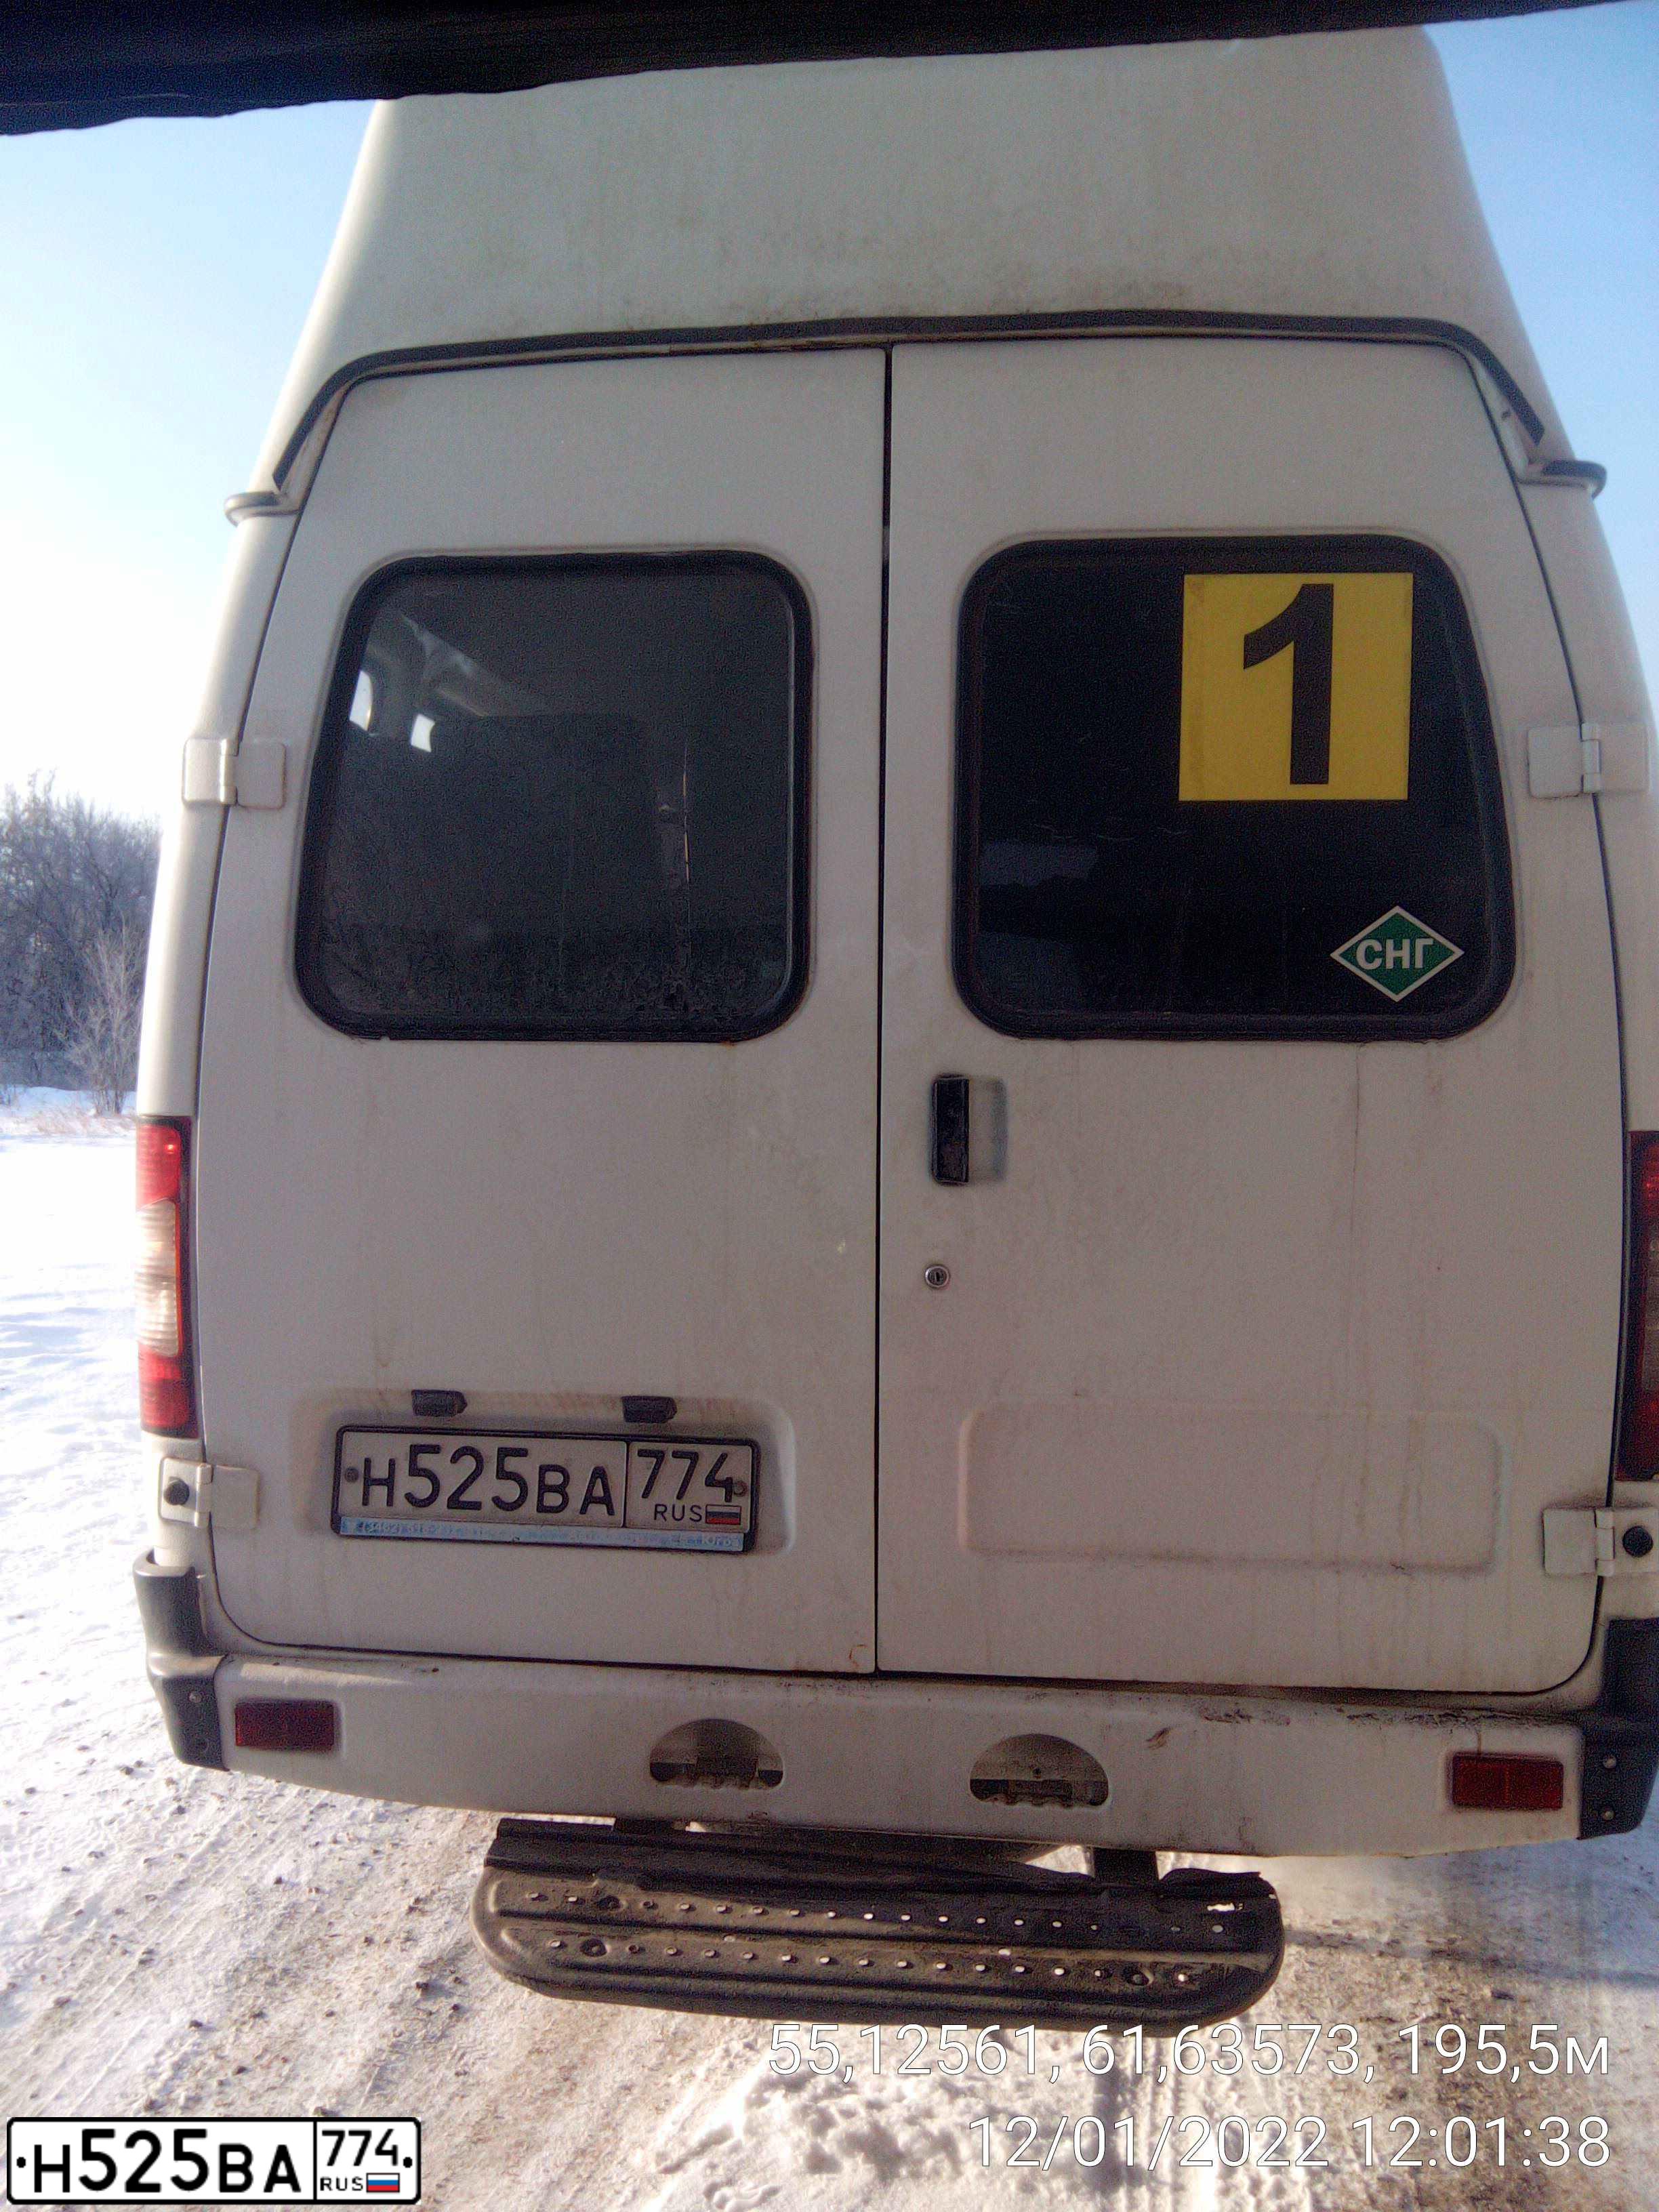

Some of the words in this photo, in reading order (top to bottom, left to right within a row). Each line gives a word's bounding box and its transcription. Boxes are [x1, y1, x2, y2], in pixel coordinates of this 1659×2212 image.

[1243, 583, 1334, 785] 1
[1355, 937, 1434, 970] СНГ
[637, 1448, 734, 1503] 774
[653, 1503, 703, 1523] RUS
